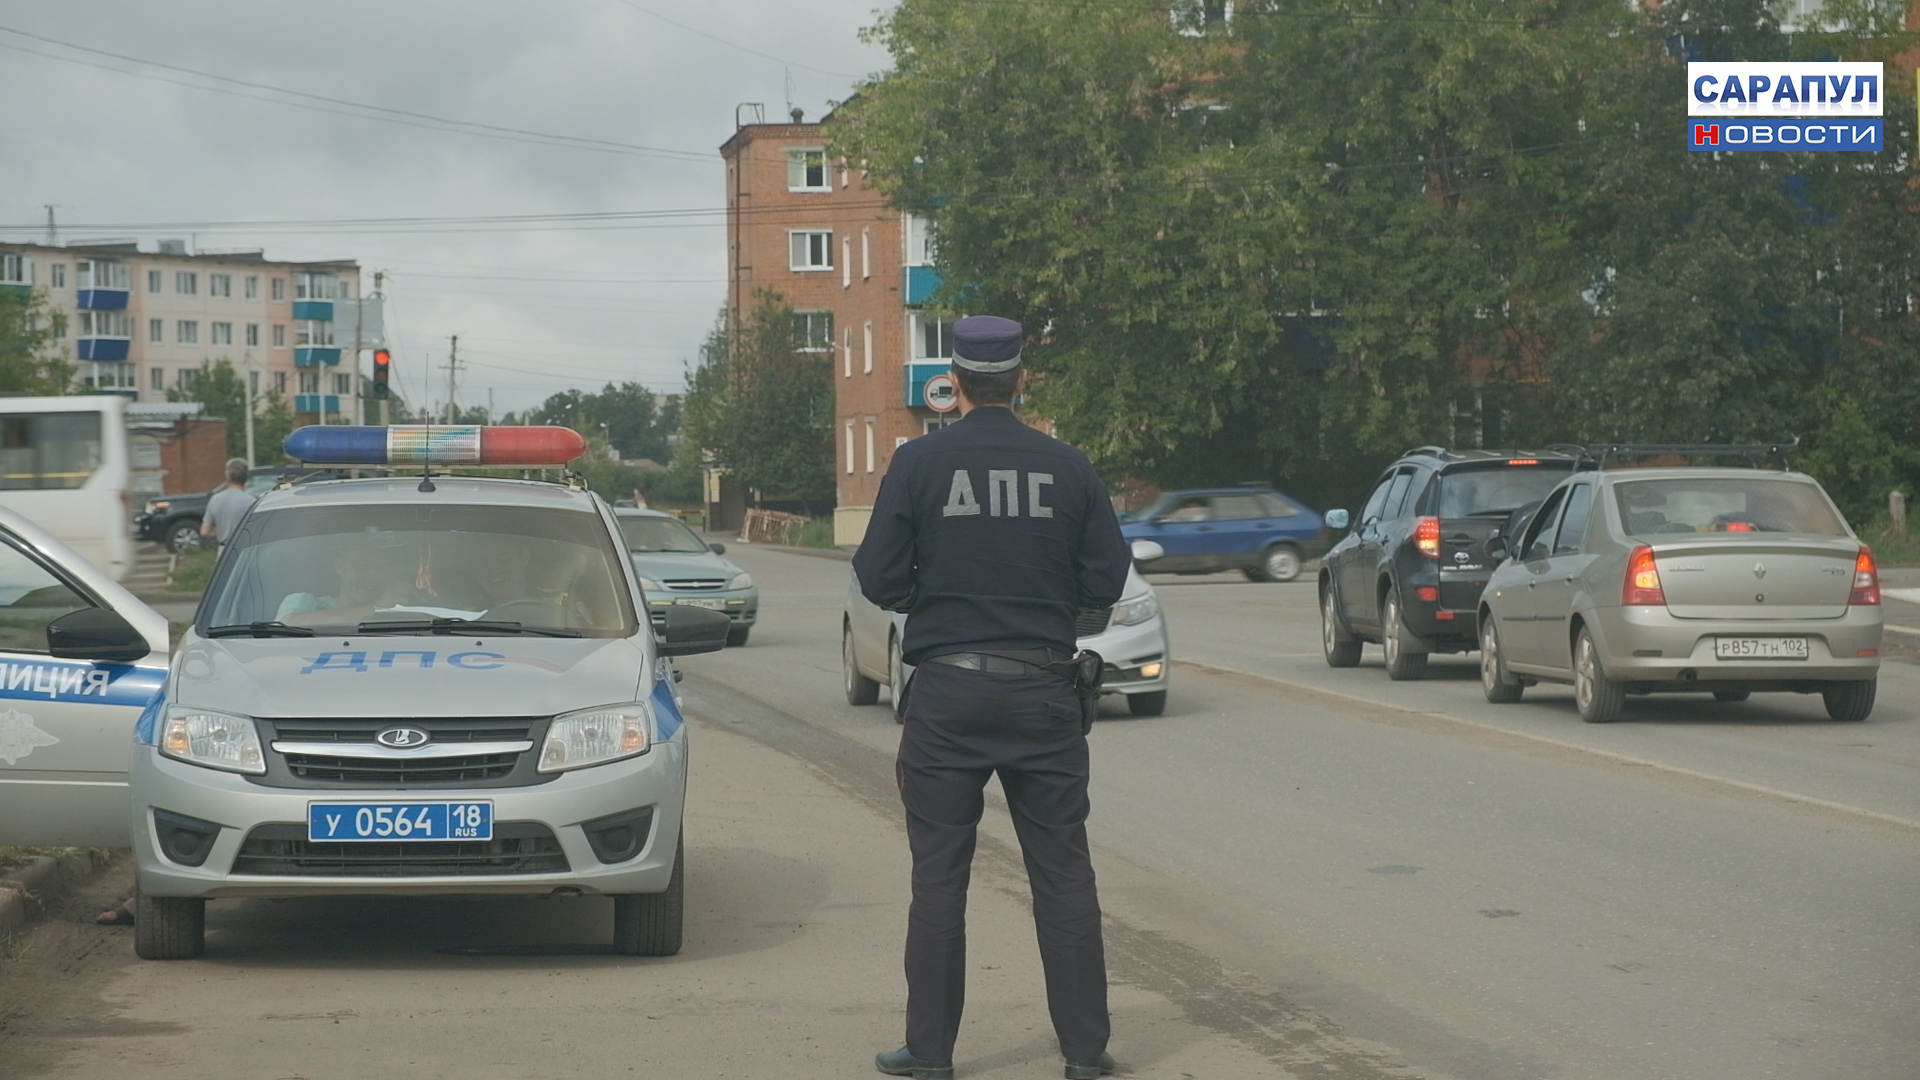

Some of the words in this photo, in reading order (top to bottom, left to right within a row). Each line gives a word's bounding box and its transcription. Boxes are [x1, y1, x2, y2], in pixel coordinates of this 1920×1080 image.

[943, 469, 1054, 518] ДПС
[300, 651, 505, 675] ДПС
[355, 807, 432, 837] 0564
[452, 805, 482, 828] 18
[454, 827, 478, 837] RUS
